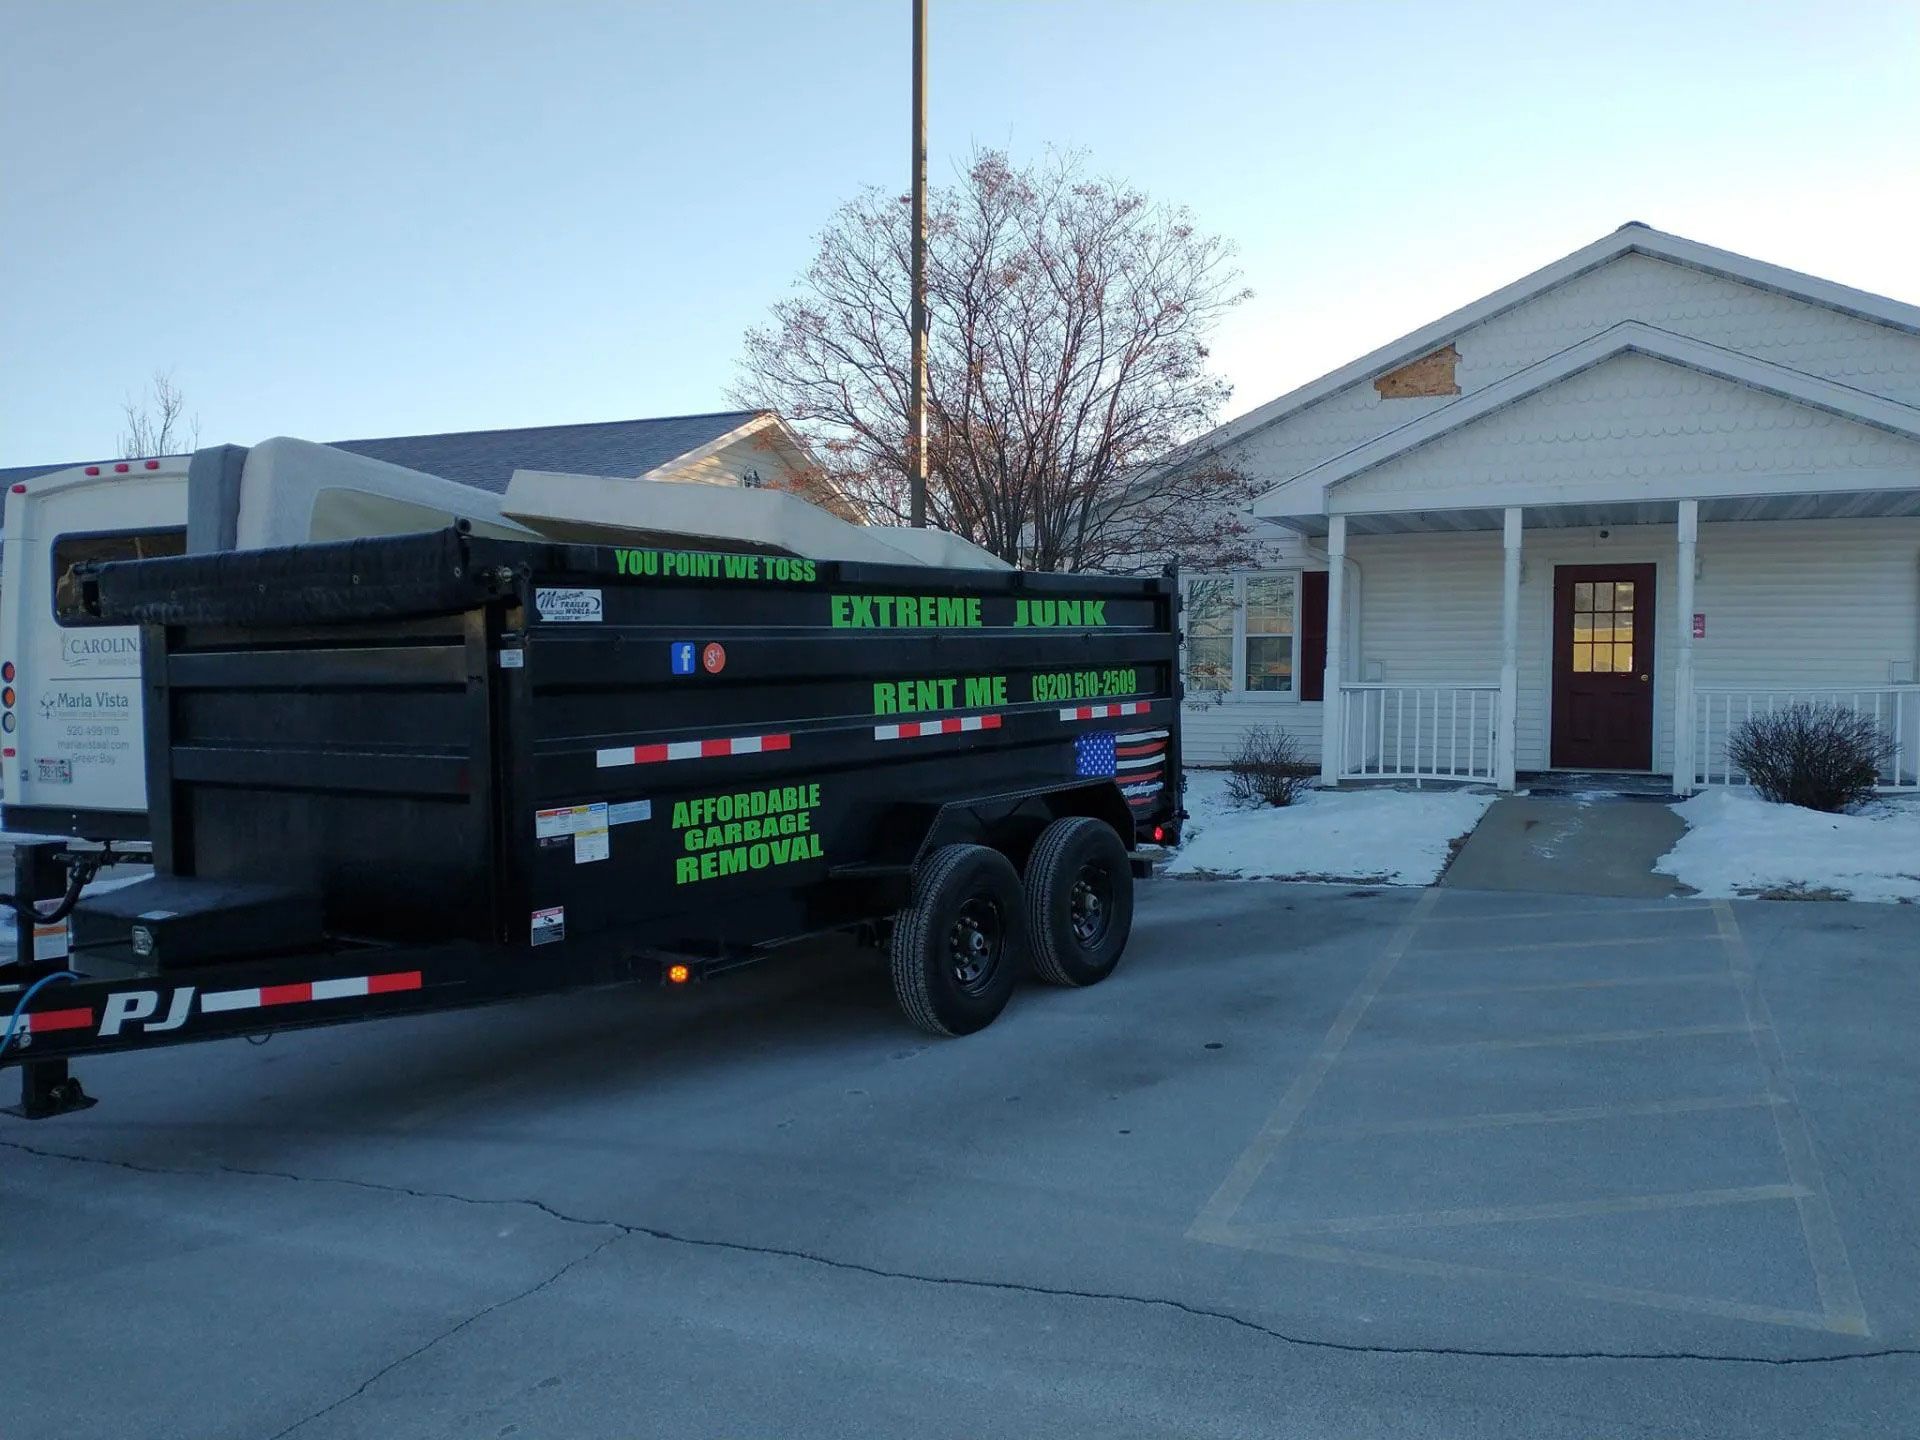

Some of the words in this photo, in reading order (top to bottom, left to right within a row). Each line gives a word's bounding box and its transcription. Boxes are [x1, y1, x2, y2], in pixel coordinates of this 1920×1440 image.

[615, 550, 658, 576] YOU
[663, 552, 721, 578] POINT
[723, 555, 759, 579] WE
[764, 558, 816, 582] TOSS
[832, 595, 983, 628] EXTREME
[1014, 599, 1107, 628] JUNK
[70, 637, 138, 654] CAROLIN
[57, 692, 92, 708] Marla
[96, 691, 129, 708] Vista
[874, 677, 957, 715] RENT
[965, 676, 1008, 707] ME
[1032, 673, 1072, 702] (920)
[1074, 669, 1137, 698] 510-2509
[672, 784, 820, 829] AFFORDABLE
[684, 811, 810, 851] GARBAGE
[676, 833, 824, 885] REMOVAL
[97, 986, 196, 1037] PJ
